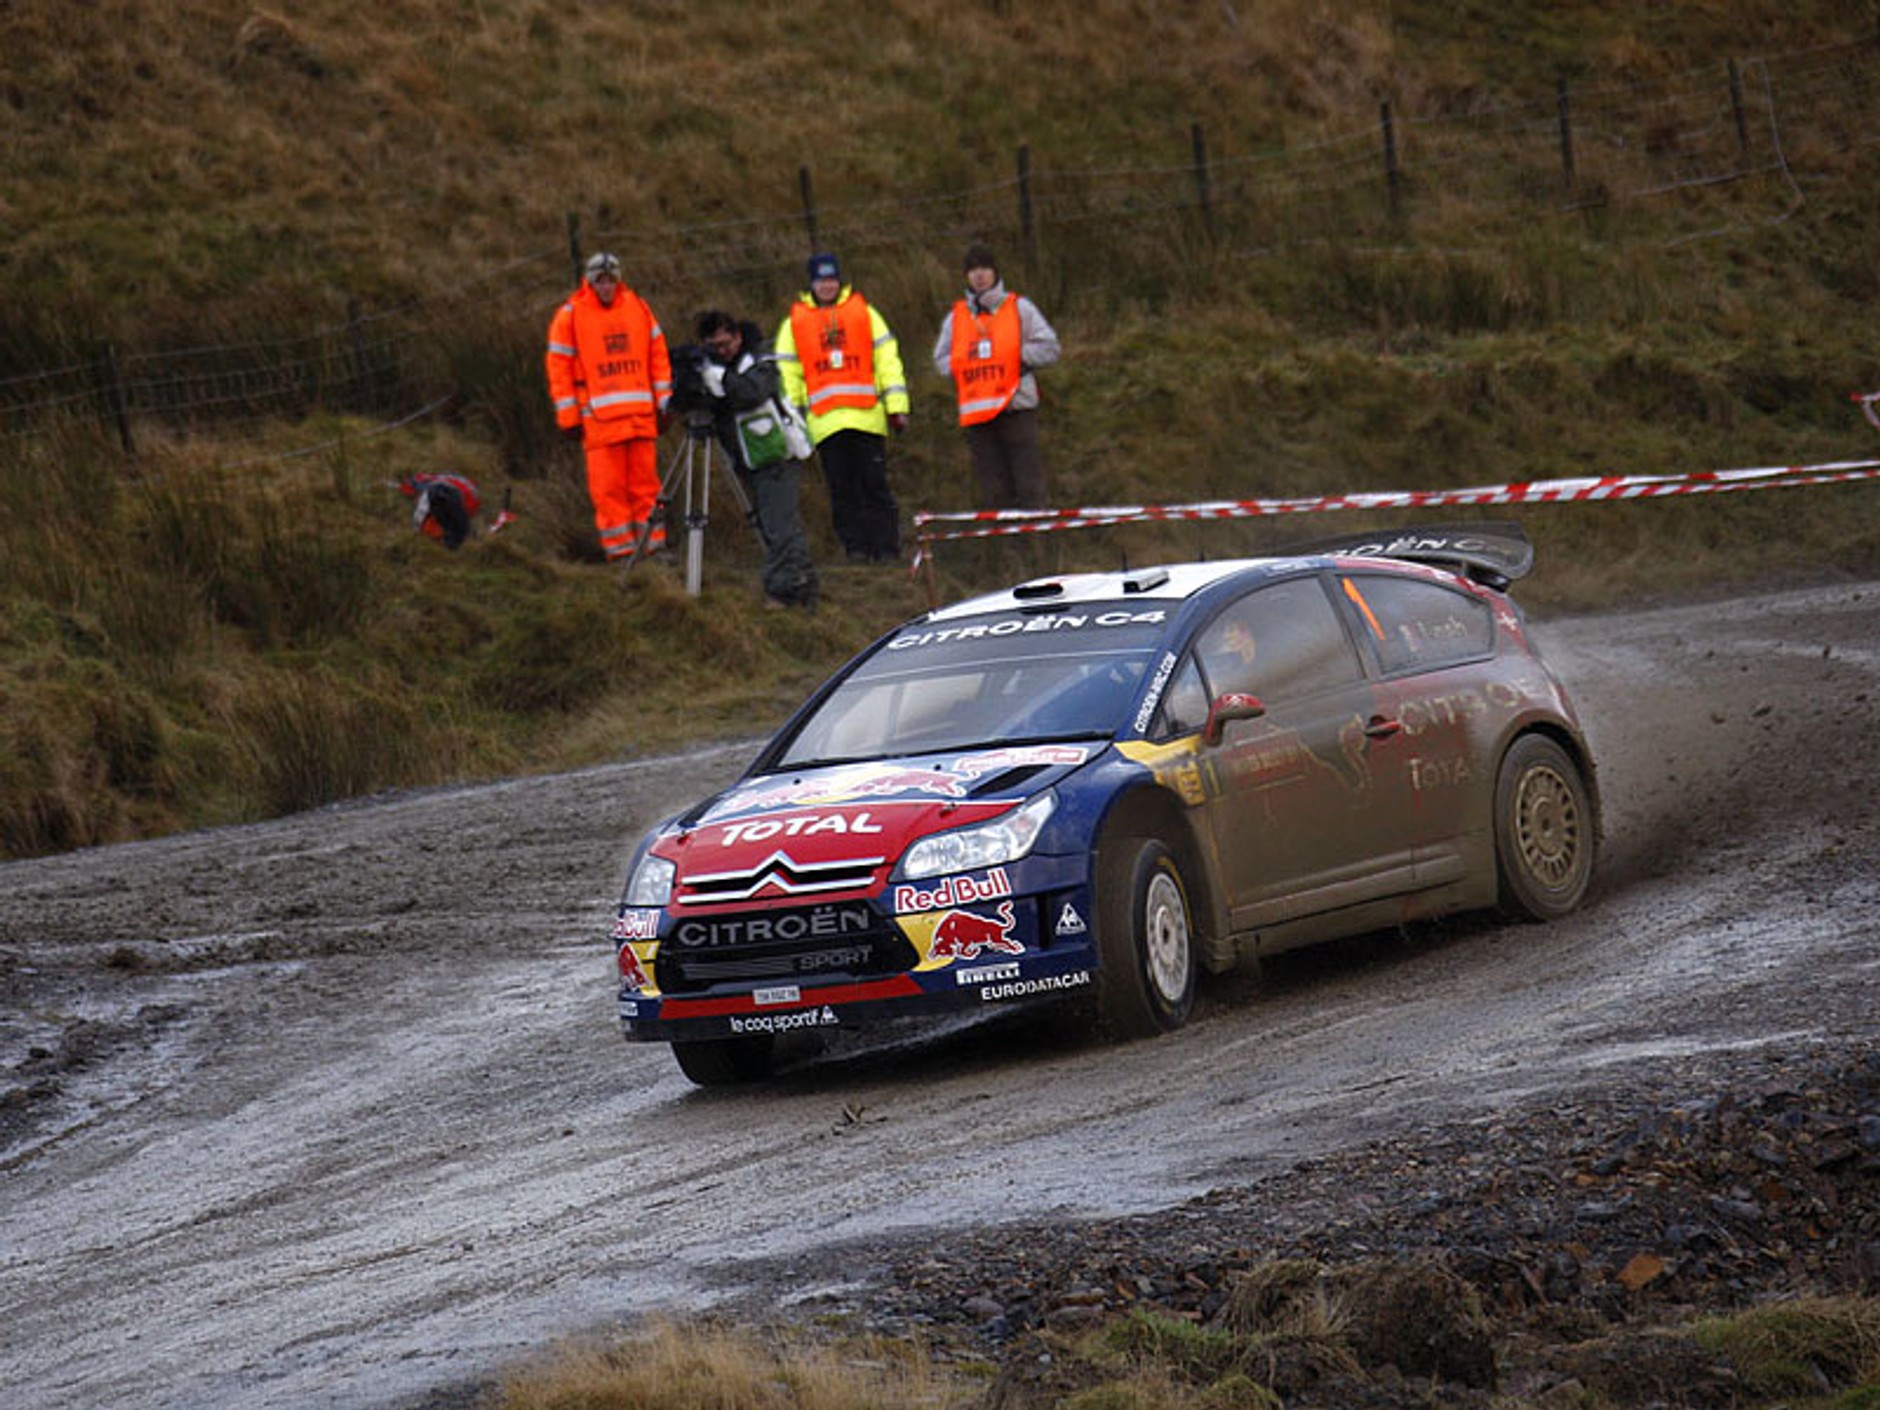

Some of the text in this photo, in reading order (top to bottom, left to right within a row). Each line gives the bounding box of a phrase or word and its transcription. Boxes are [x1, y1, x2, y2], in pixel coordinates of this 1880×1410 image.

[597, 360, 641, 378] SAFETY
[815, 355, 861, 376] SATY
[962, 364, 1006, 384] SAFETY
[887, 610, 1167, 650] CITROËN C4
[720, 812, 884, 847] TOTAL
[895, 867, 1012, 914] Red Bull
[678, 906, 870, 947] CITROËN
[799, 946, 873, 971] SPORT
[980, 971, 1091, 1001] EURODATACAR
[730, 1008, 819, 1034] le coq sportif
